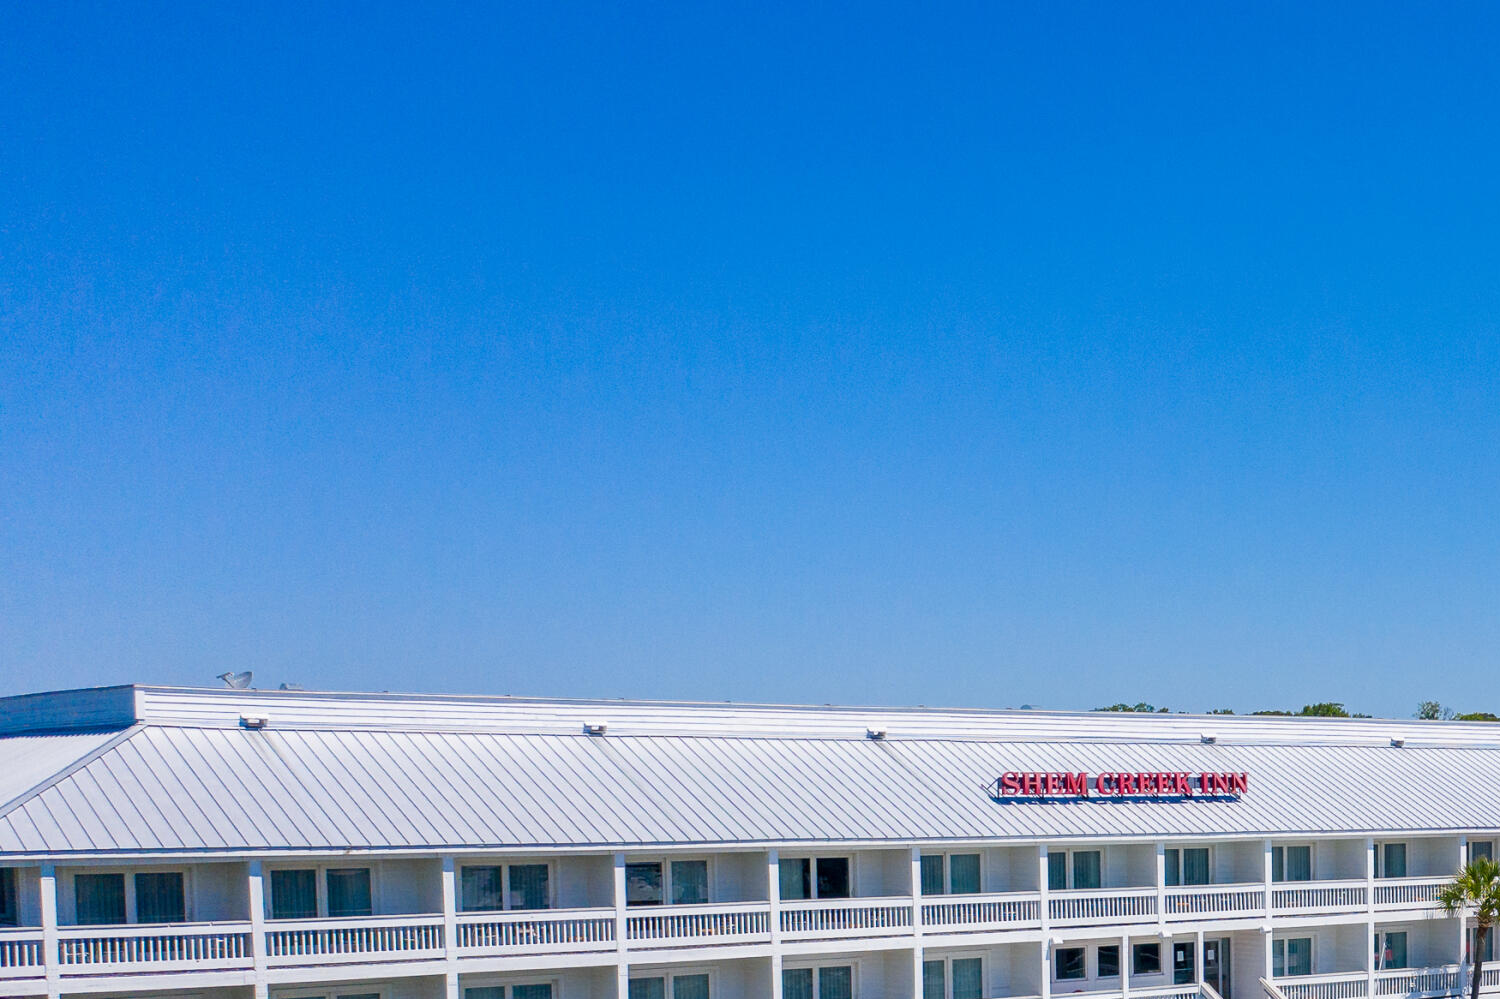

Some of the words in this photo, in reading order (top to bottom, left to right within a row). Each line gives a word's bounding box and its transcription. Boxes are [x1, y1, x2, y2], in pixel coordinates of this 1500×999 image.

[1001, 771, 1089, 795] SHEM
[1096, 771, 1193, 795] CREEK
[1200, 772, 1250, 794] INN
